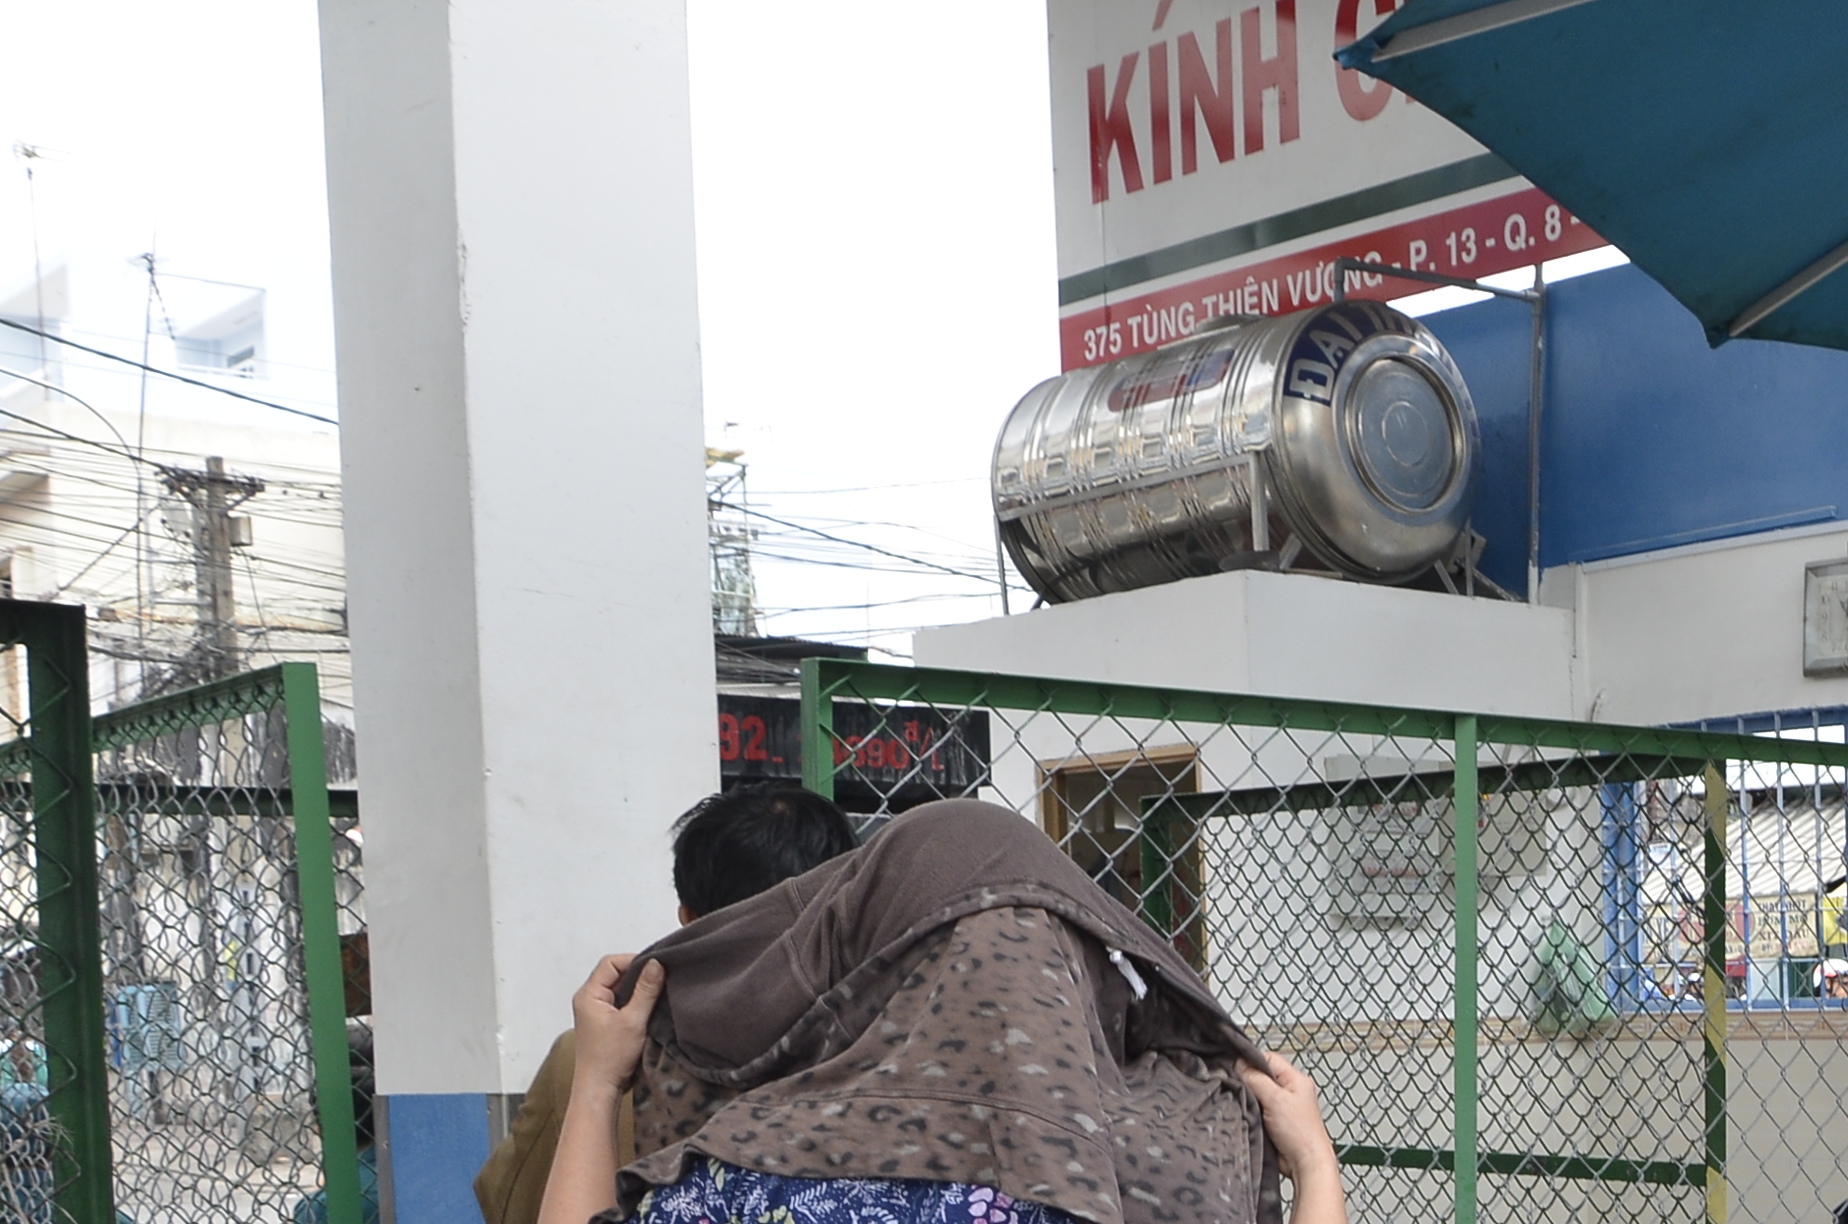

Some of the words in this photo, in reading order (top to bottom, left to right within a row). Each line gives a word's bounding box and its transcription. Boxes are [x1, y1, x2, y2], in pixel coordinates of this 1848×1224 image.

[1087, 0, 1300, 205] KÍNH
[1084, 322, 1122, 361] 375
[1127, 304, 1195, 348] TÙNG
[1446, 227, 1478, 267] 13
[1544, 204, 1562, 242] 8
